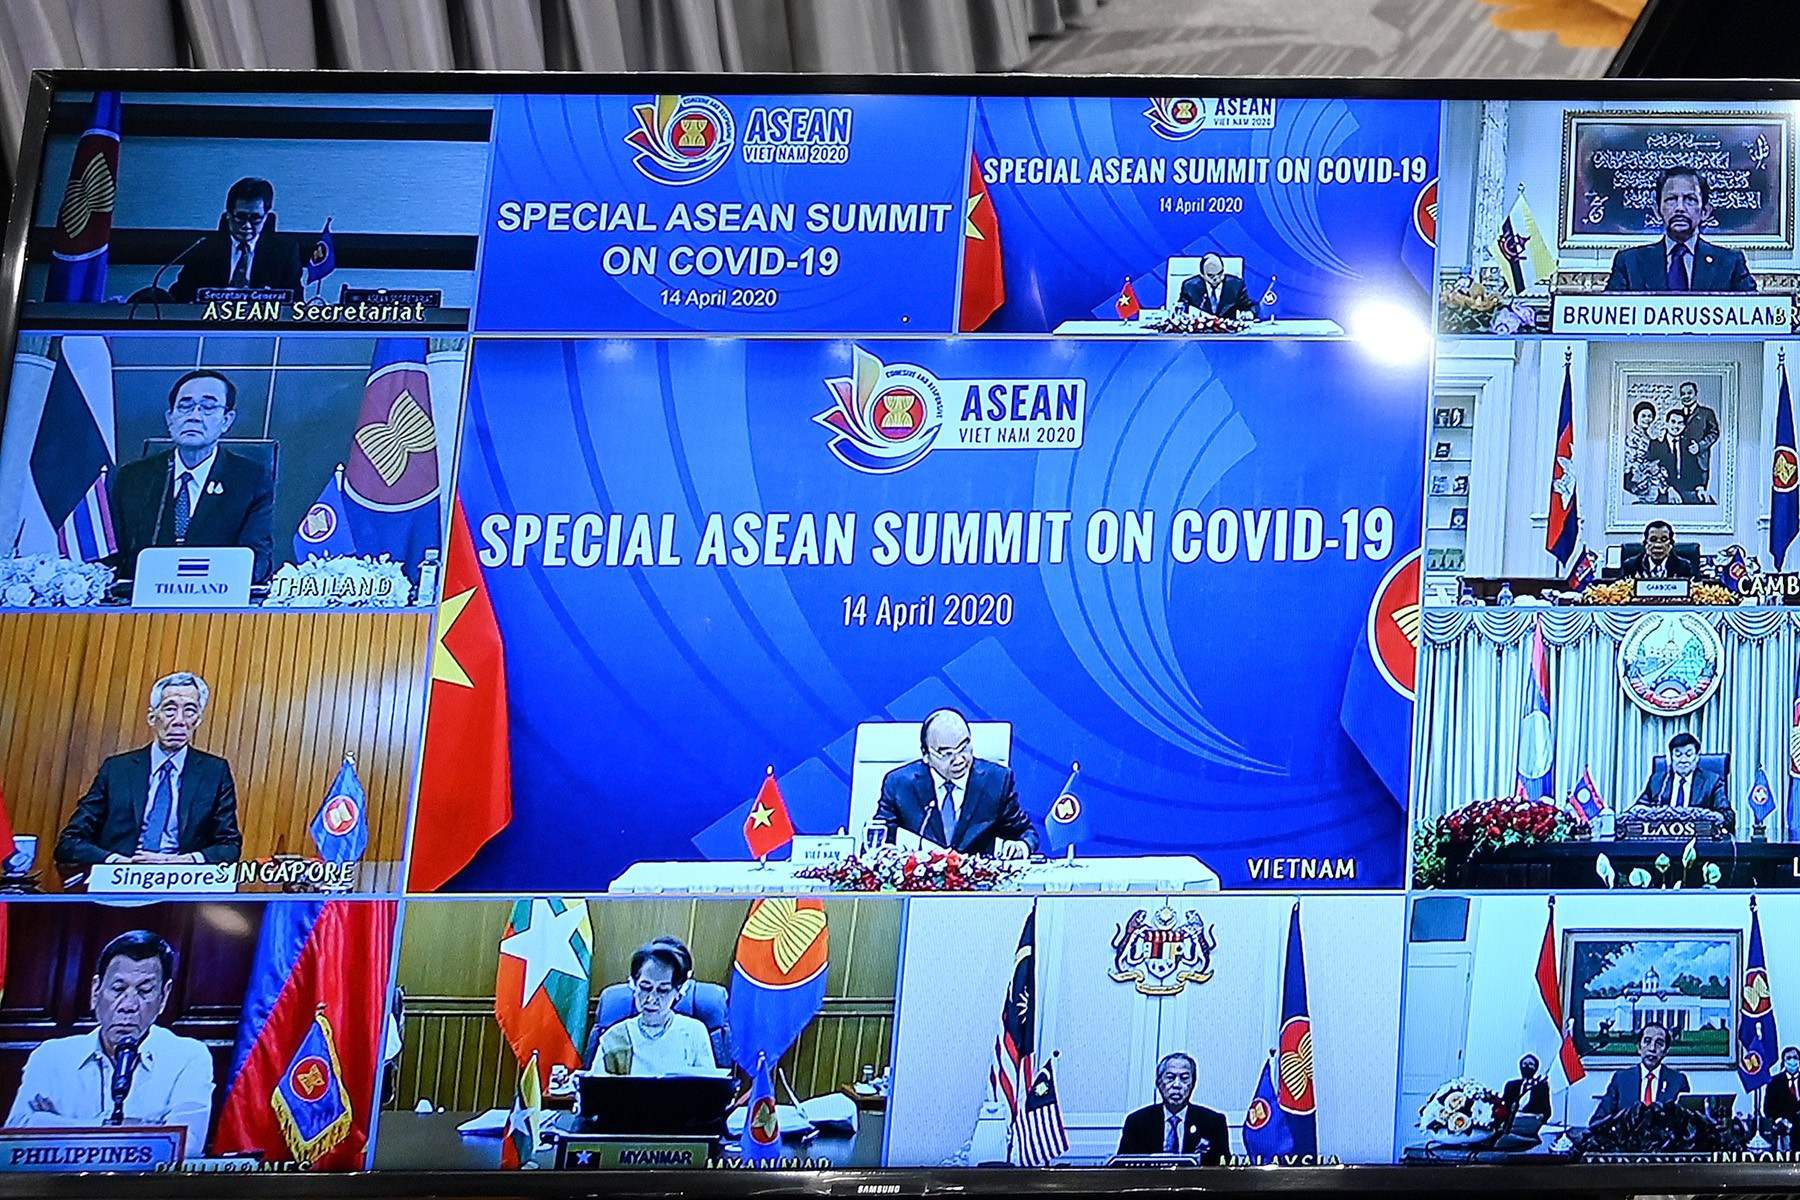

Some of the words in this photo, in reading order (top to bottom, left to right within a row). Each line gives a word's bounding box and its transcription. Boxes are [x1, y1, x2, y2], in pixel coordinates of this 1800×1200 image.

[1215, 98, 1272, 116] ASEAN
[744, 108, 853, 144] ASEAN
[743, 146, 774, 163] VIET
[777, 146, 808, 163] NAM
[810, 146, 849, 163] 2020
[983, 156, 1082, 184] SPECIAL
[1088, 156, 1167, 184] ASEAN
[1172, 156, 1269, 184] SUMMIT
[1276, 156, 1309, 184] ON
[1316, 156, 1428, 184] COVID-19
[1159, 197, 1172, 213] 14
[1175, 197, 1205, 215] April
[1208, 197, 1244, 213] 2020
[497, 201, 659, 233] SPECIAL
[665, 202, 796, 233] ASEAN
[806, 202, 952, 234] SUMMIT
[602, 246, 659, 276] ON
[667, 246, 841, 277] COVID-19
[659, 289, 681, 306] 14
[681, 288, 727, 310] April
[731, 289, 779, 307] 2020
[202, 301, 280, 321] ASEAN
[292, 301, 425, 322] Secretariat
[1563, 306, 1637, 325] BRUNEI
[961, 384, 1079, 421] ASEAN
[959, 427, 990, 444] VIET
[998, 427, 1030, 443] NAM
[1037, 427, 1076, 444] 2020
[479, 513, 682, 568] SPECIAL
[695, 512, 857, 567] ASEAN
[871, 510, 1072, 567] SUMMIT
[1086, 509, 1155, 564] ON
[1170, 506, 1394, 563] COVID-19
[154, 582, 229, 595] THAILAND
[274, 576, 393, 597] THAILAND
[842, 595, 868, 627] 14
[875, 595, 935, 632] April
[942, 593, 1014, 627] 2020
[1642, 822, 1697, 837] LAOS
[112, 866, 215, 890] Singapore
[216, 860, 355, 885] SINGAPORE
[1247, 858, 1355, 879] VIETNAM
[10, 1146, 153, 1167] PHILIPPINES
[619, 1150, 693, 1166] MYANMAR
[857, 1184, 900, 1194] SAMSUNG
